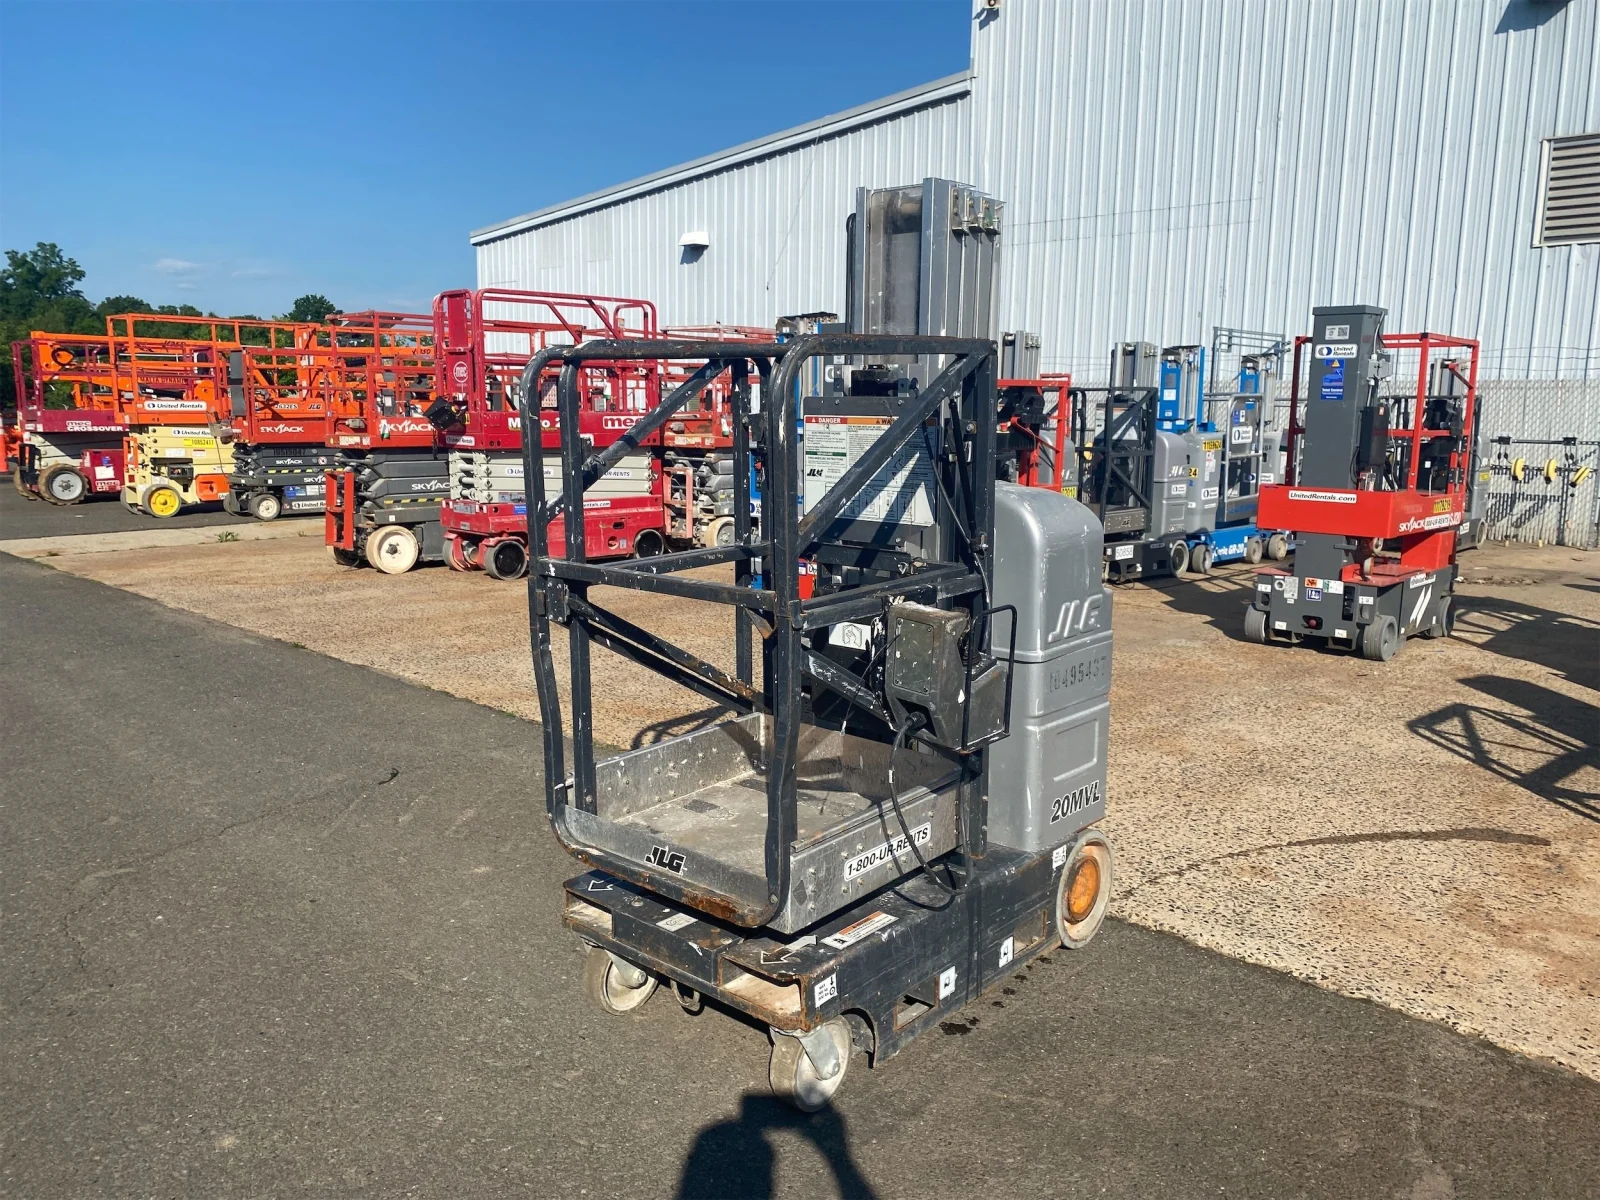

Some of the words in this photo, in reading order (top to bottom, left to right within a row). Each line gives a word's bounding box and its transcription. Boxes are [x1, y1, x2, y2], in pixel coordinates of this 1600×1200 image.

[260, 423, 305, 434] SKYJACK
[411, 480, 450, 491] SKYJAC
[1290, 492, 1357, 502] UnitedRentals.com
[1398, 516, 1427, 533] SKYJACK
[1048, 593, 1104, 643] JLG
[1050, 780, 1101, 824] 20MVL
[644, 845, 687, 876] JLG
